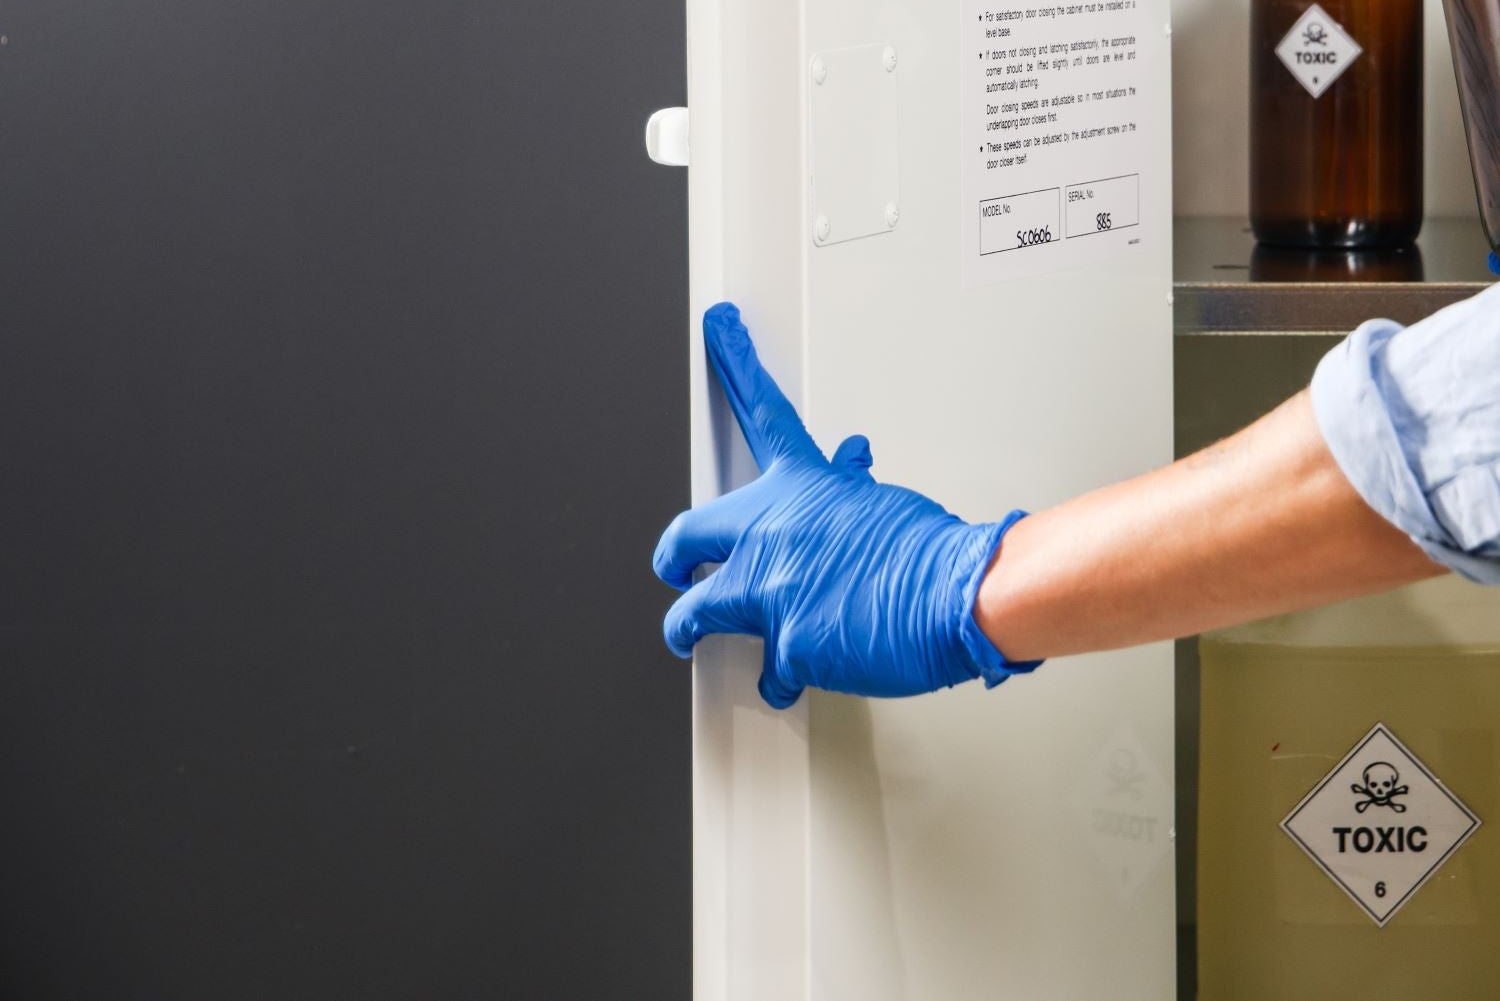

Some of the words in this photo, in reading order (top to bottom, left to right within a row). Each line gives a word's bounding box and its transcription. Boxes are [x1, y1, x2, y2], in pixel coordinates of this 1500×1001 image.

[1295, 52, 1337, 64] TOXIC
[1068, 191, 1085, 203] SERIAL
[983, 204, 1001, 217] MODEL
[1332, 826, 1428, 853] TOXIC
[1374, 881, 1386, 898] 6
